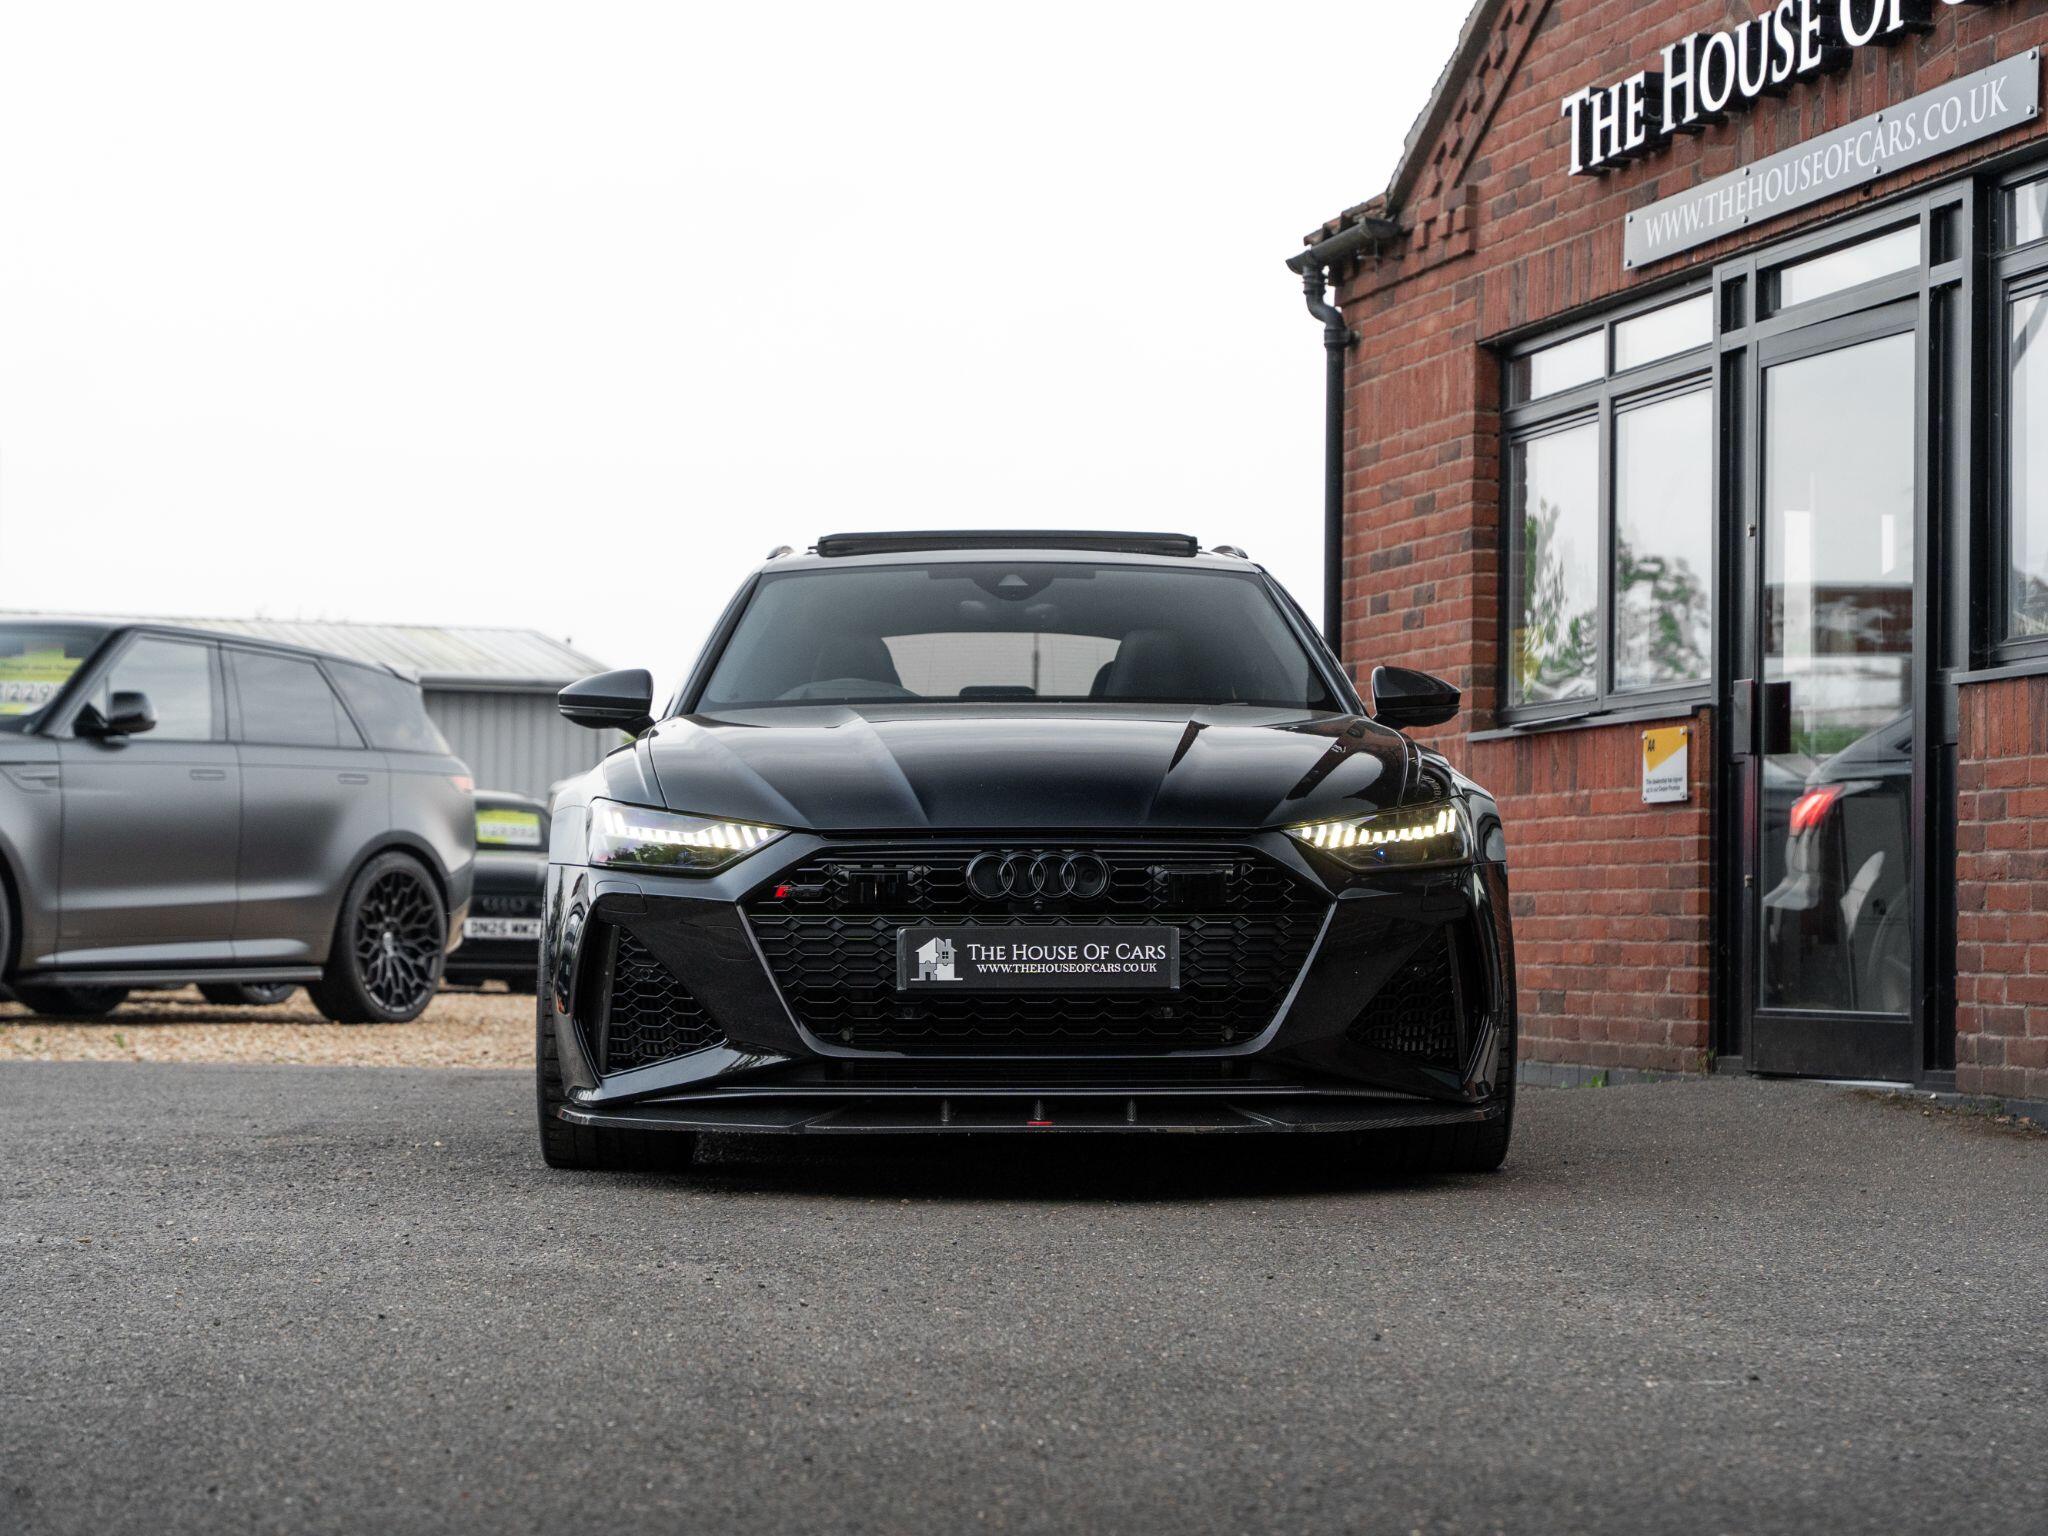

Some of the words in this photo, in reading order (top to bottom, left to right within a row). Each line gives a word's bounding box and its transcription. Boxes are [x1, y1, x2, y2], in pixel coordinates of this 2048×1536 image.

[1561, 70, 1646, 177] THE
[1659, 0, 1822, 135] HOUSE
[1644, 76, 2009, 249] WWW.THEHOUSEOFCARS.CO.UK
[966, 943, 1007, 961] THE
[1011, 943, 1079, 961] HOUSE
[1083, 943, 1110, 960] OF
[1115, 943, 1166, 960] CARS
[976, 963, 1158, 973] WWW.THEHOUSEOFCARSCOUK
